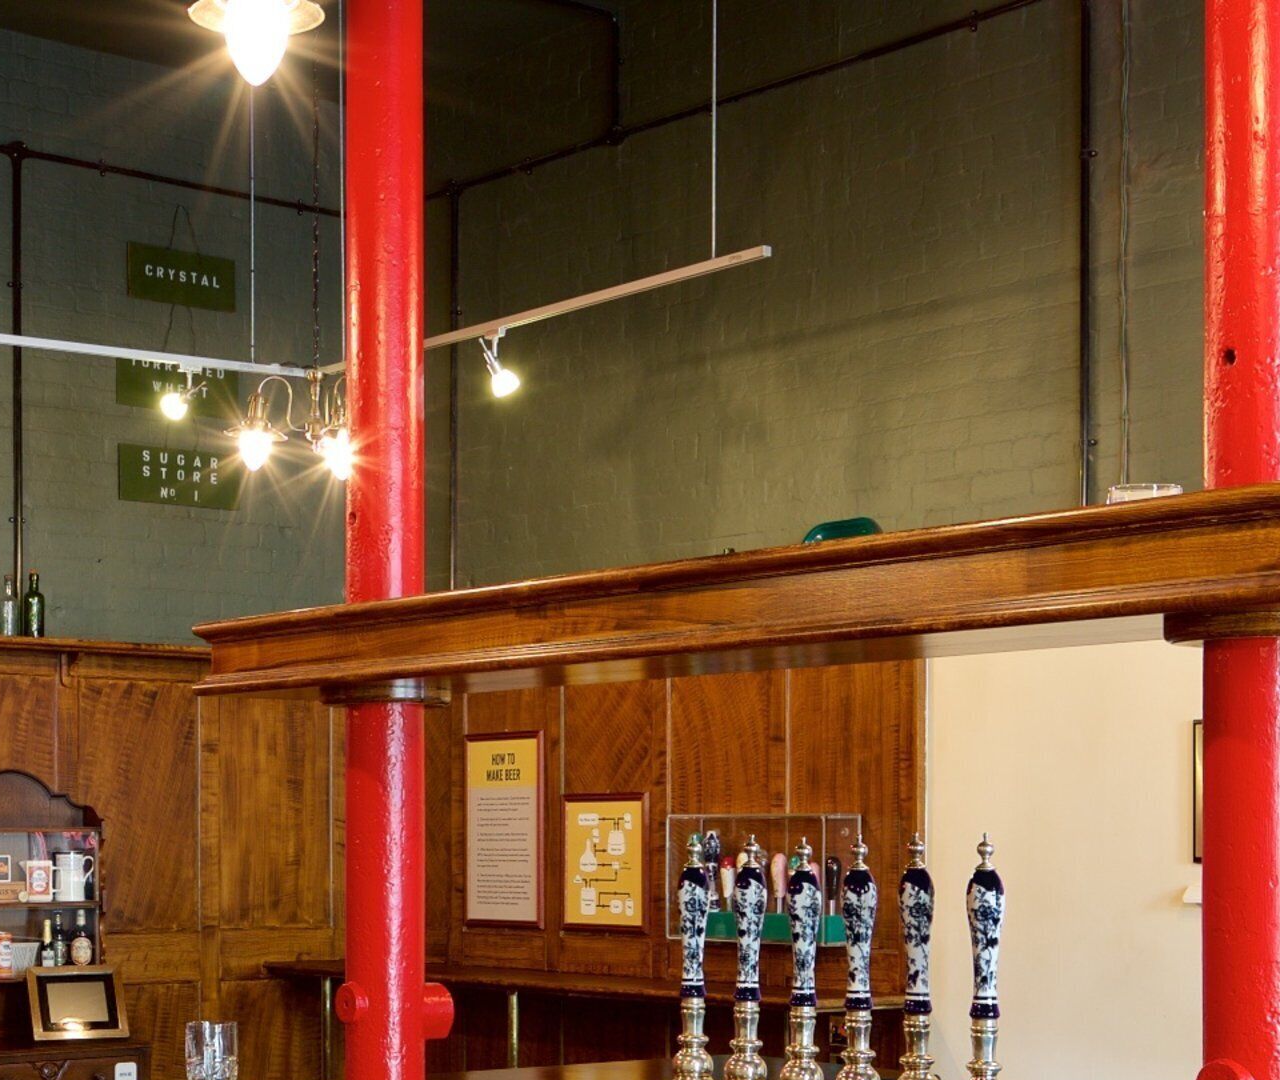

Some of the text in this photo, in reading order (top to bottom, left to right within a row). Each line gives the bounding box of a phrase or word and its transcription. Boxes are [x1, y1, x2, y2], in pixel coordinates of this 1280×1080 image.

[145, 264, 220, 289] CRYSTAL
[152, 381, 208, 399] WHET
[142, 450, 218, 469] SUGAR
[142, 465, 218, 485] STORE
[491, 752, 516, 766] HOW TO
[486, 768, 521, 782] MAKE BEER
